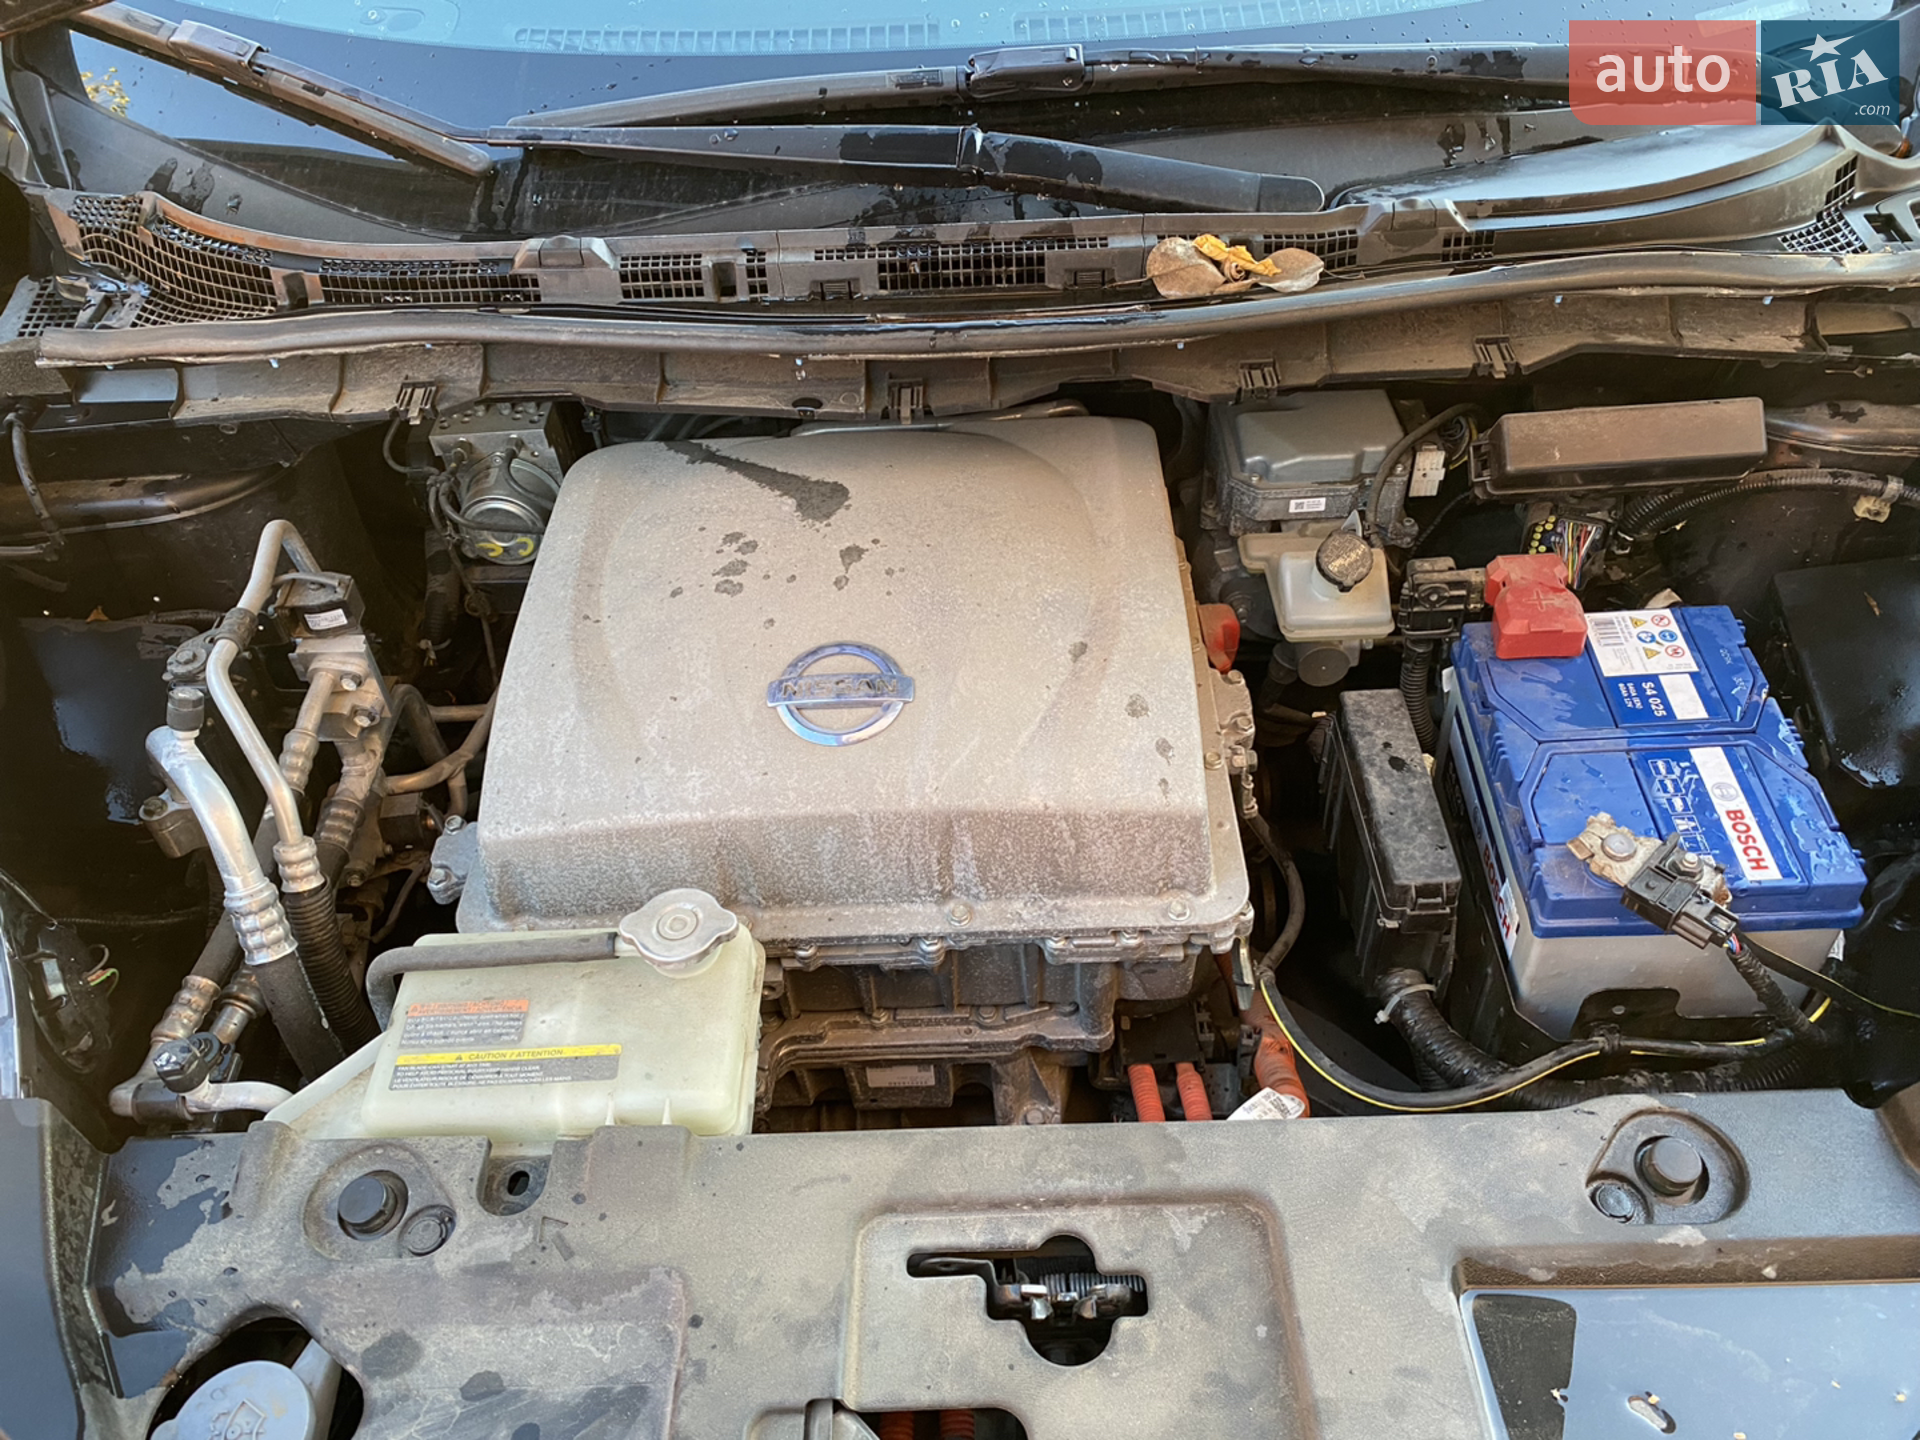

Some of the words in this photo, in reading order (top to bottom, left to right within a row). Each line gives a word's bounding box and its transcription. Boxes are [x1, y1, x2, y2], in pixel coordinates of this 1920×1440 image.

[782, 679, 897, 698] NISSAN
[1642, 681, 1658, 696] S4
[1648, 697, 1667, 717] 025
[1725, 809, 1770, 871] BOSCH
[1484, 844, 1511, 938] BOSCH
[469, 1051, 506, 1061] CAUTION
[509, 1051, 515, 1060] /
[516, 1049, 563, 1059] ATTENTION
